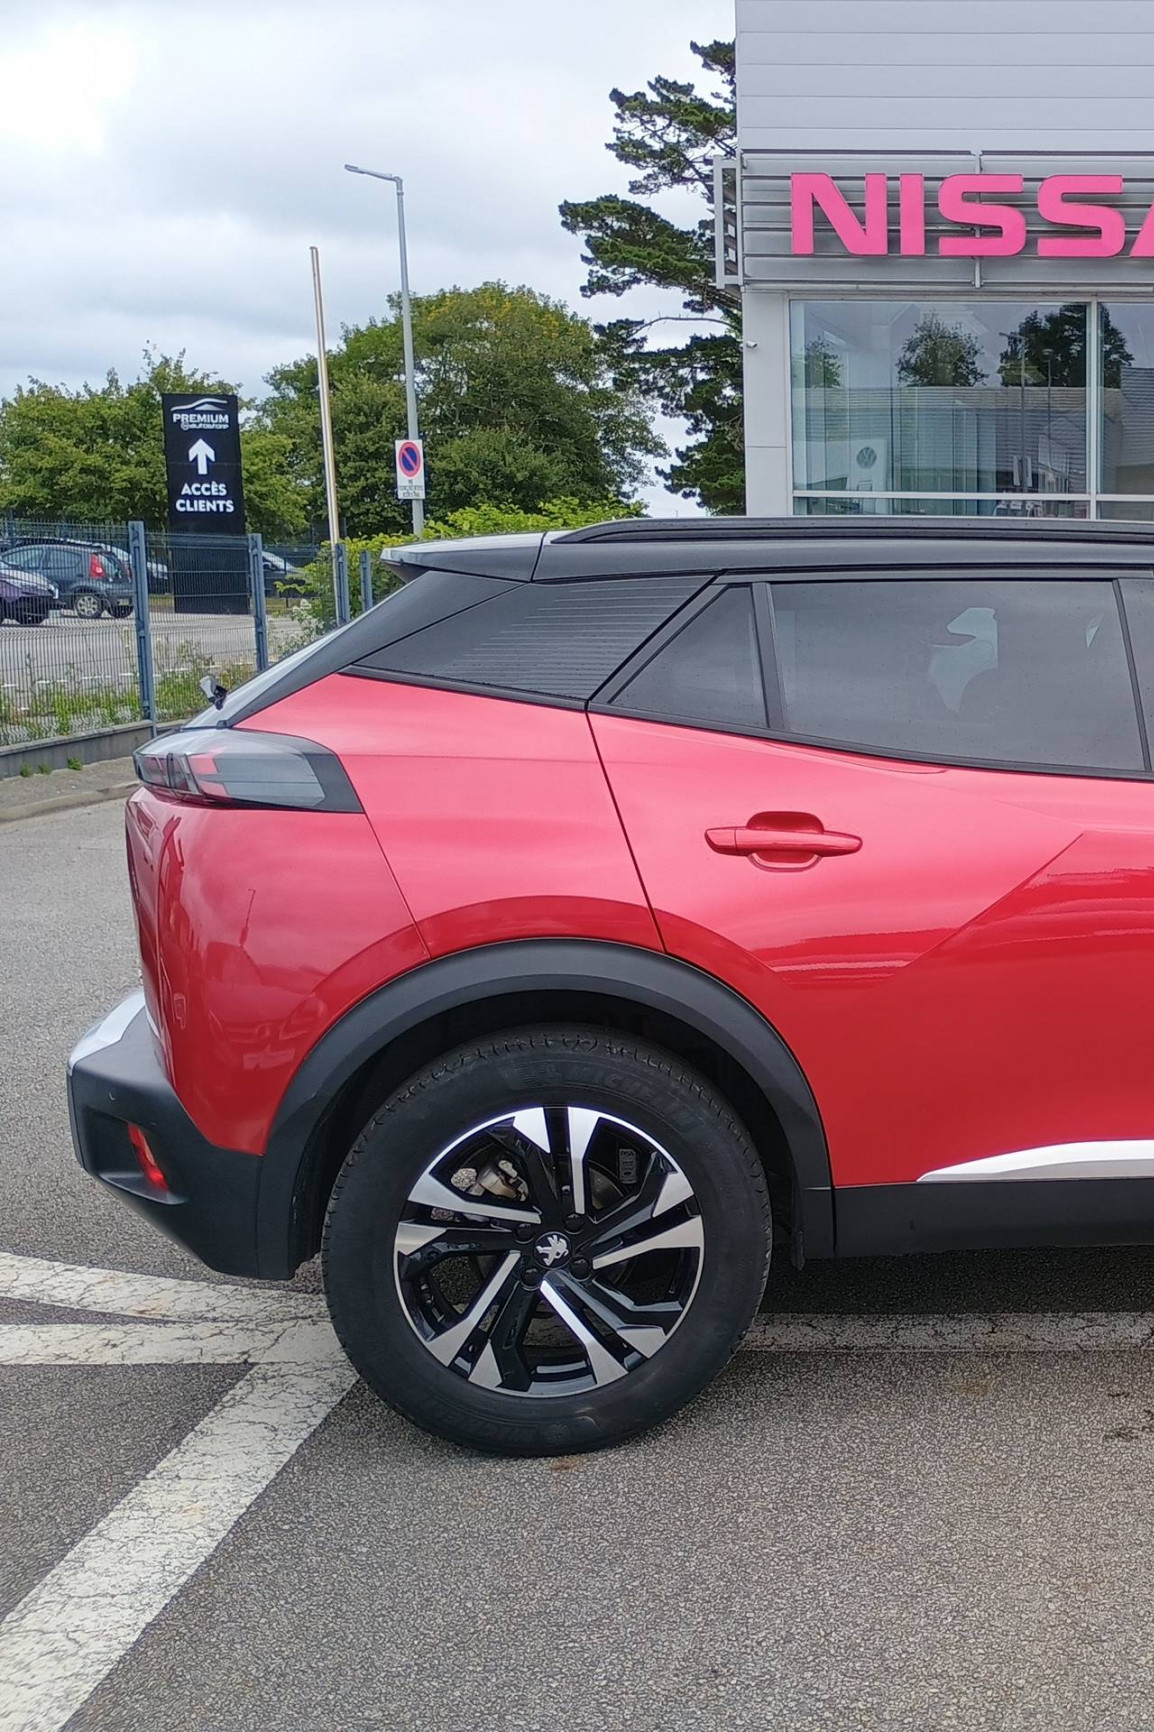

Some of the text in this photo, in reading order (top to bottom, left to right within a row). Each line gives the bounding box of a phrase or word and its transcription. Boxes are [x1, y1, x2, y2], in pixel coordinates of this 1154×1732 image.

[173, 413, 229, 424] PREMIUM
[181, 481, 227, 496] ACCÈS
[175, 499, 234, 513] CLIENTS
